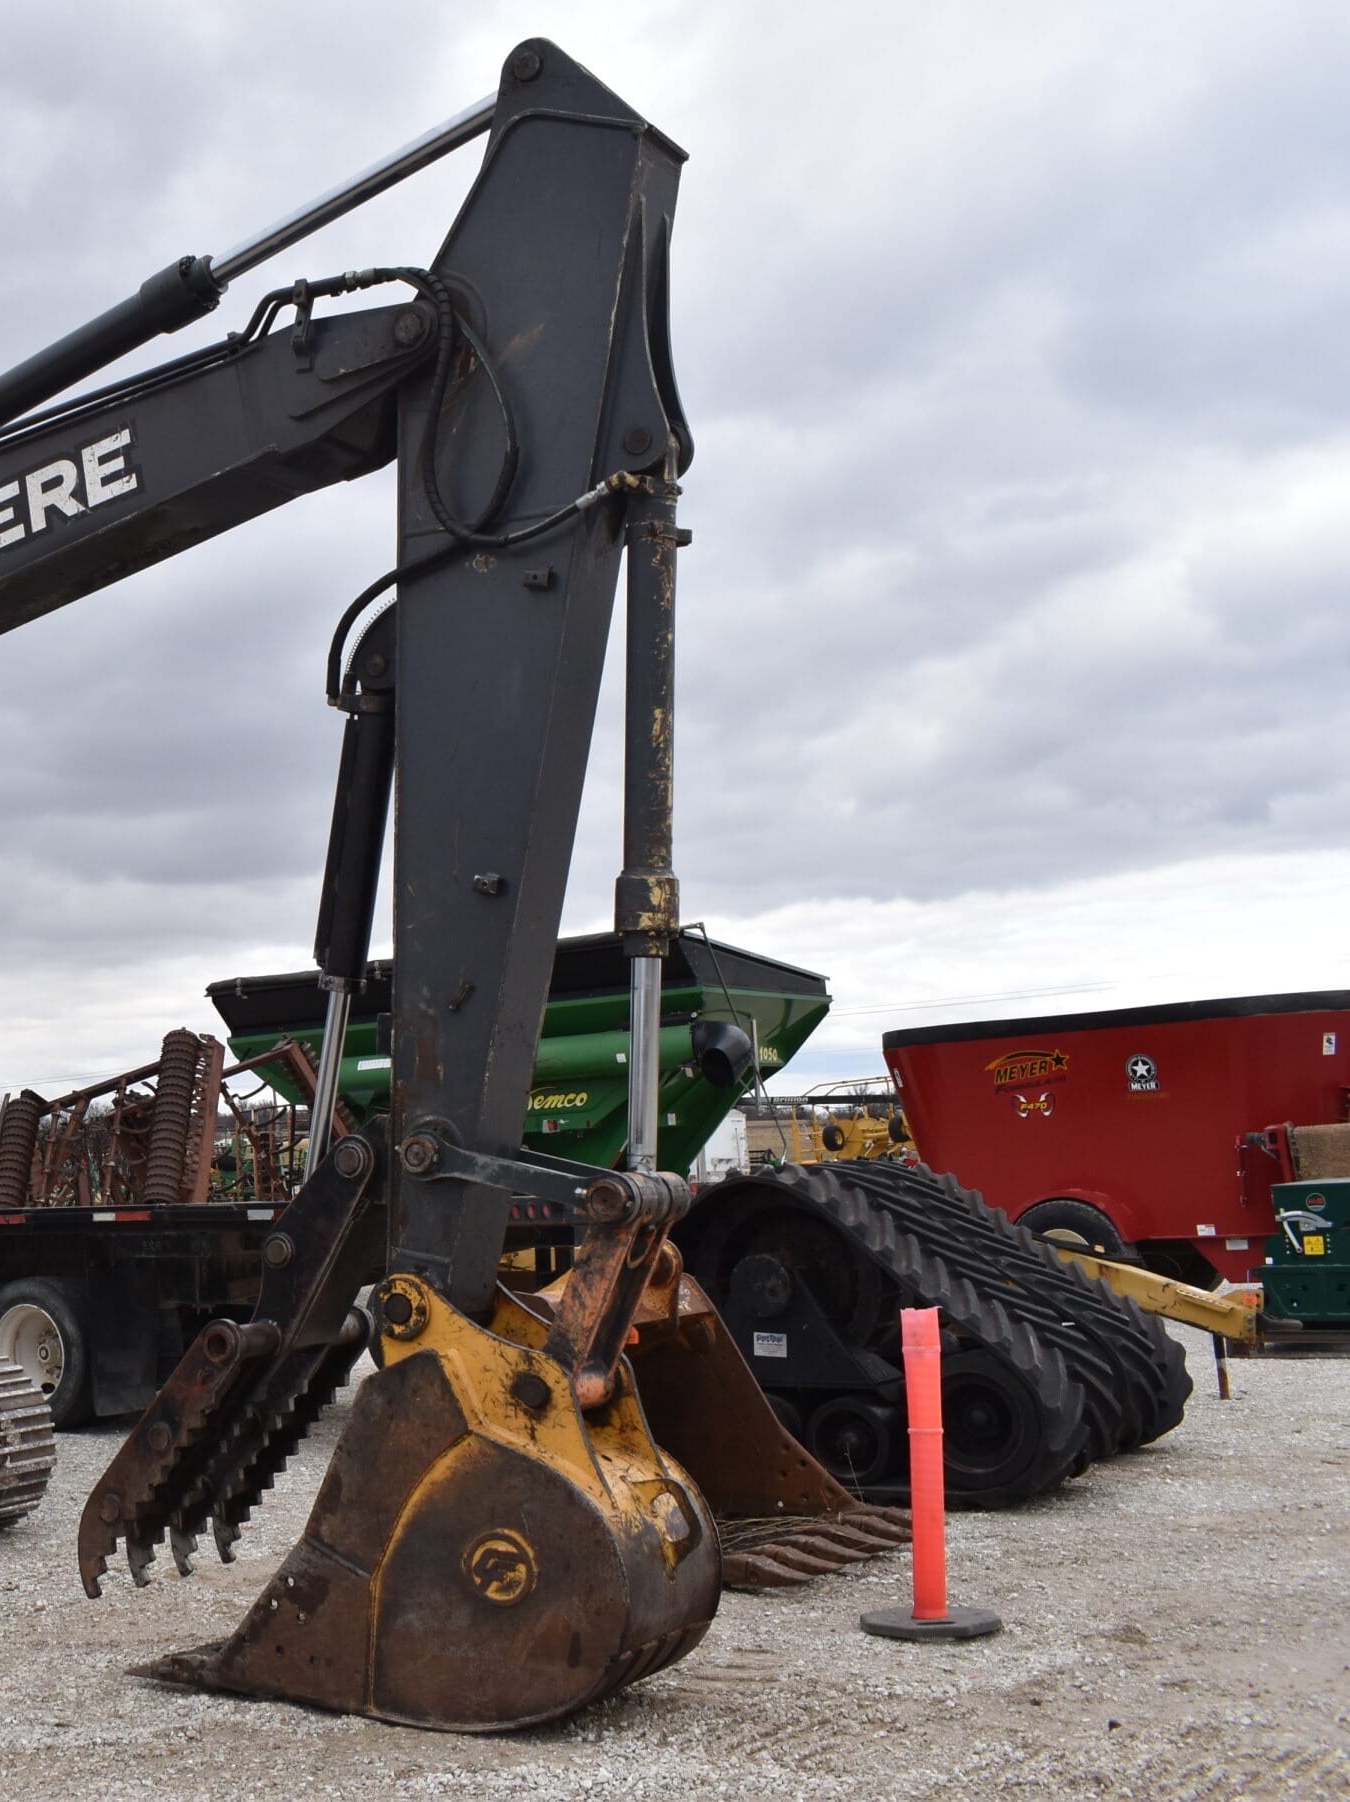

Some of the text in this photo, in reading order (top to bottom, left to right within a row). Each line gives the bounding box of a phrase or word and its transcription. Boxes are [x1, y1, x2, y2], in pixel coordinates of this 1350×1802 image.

[759, 1047, 778, 1061] 1050
[994, 1060, 1049, 1084] MEYER
[1130, 1081, 1156, 1090] MEYER
[1019, 1102, 1048, 1111] F470
